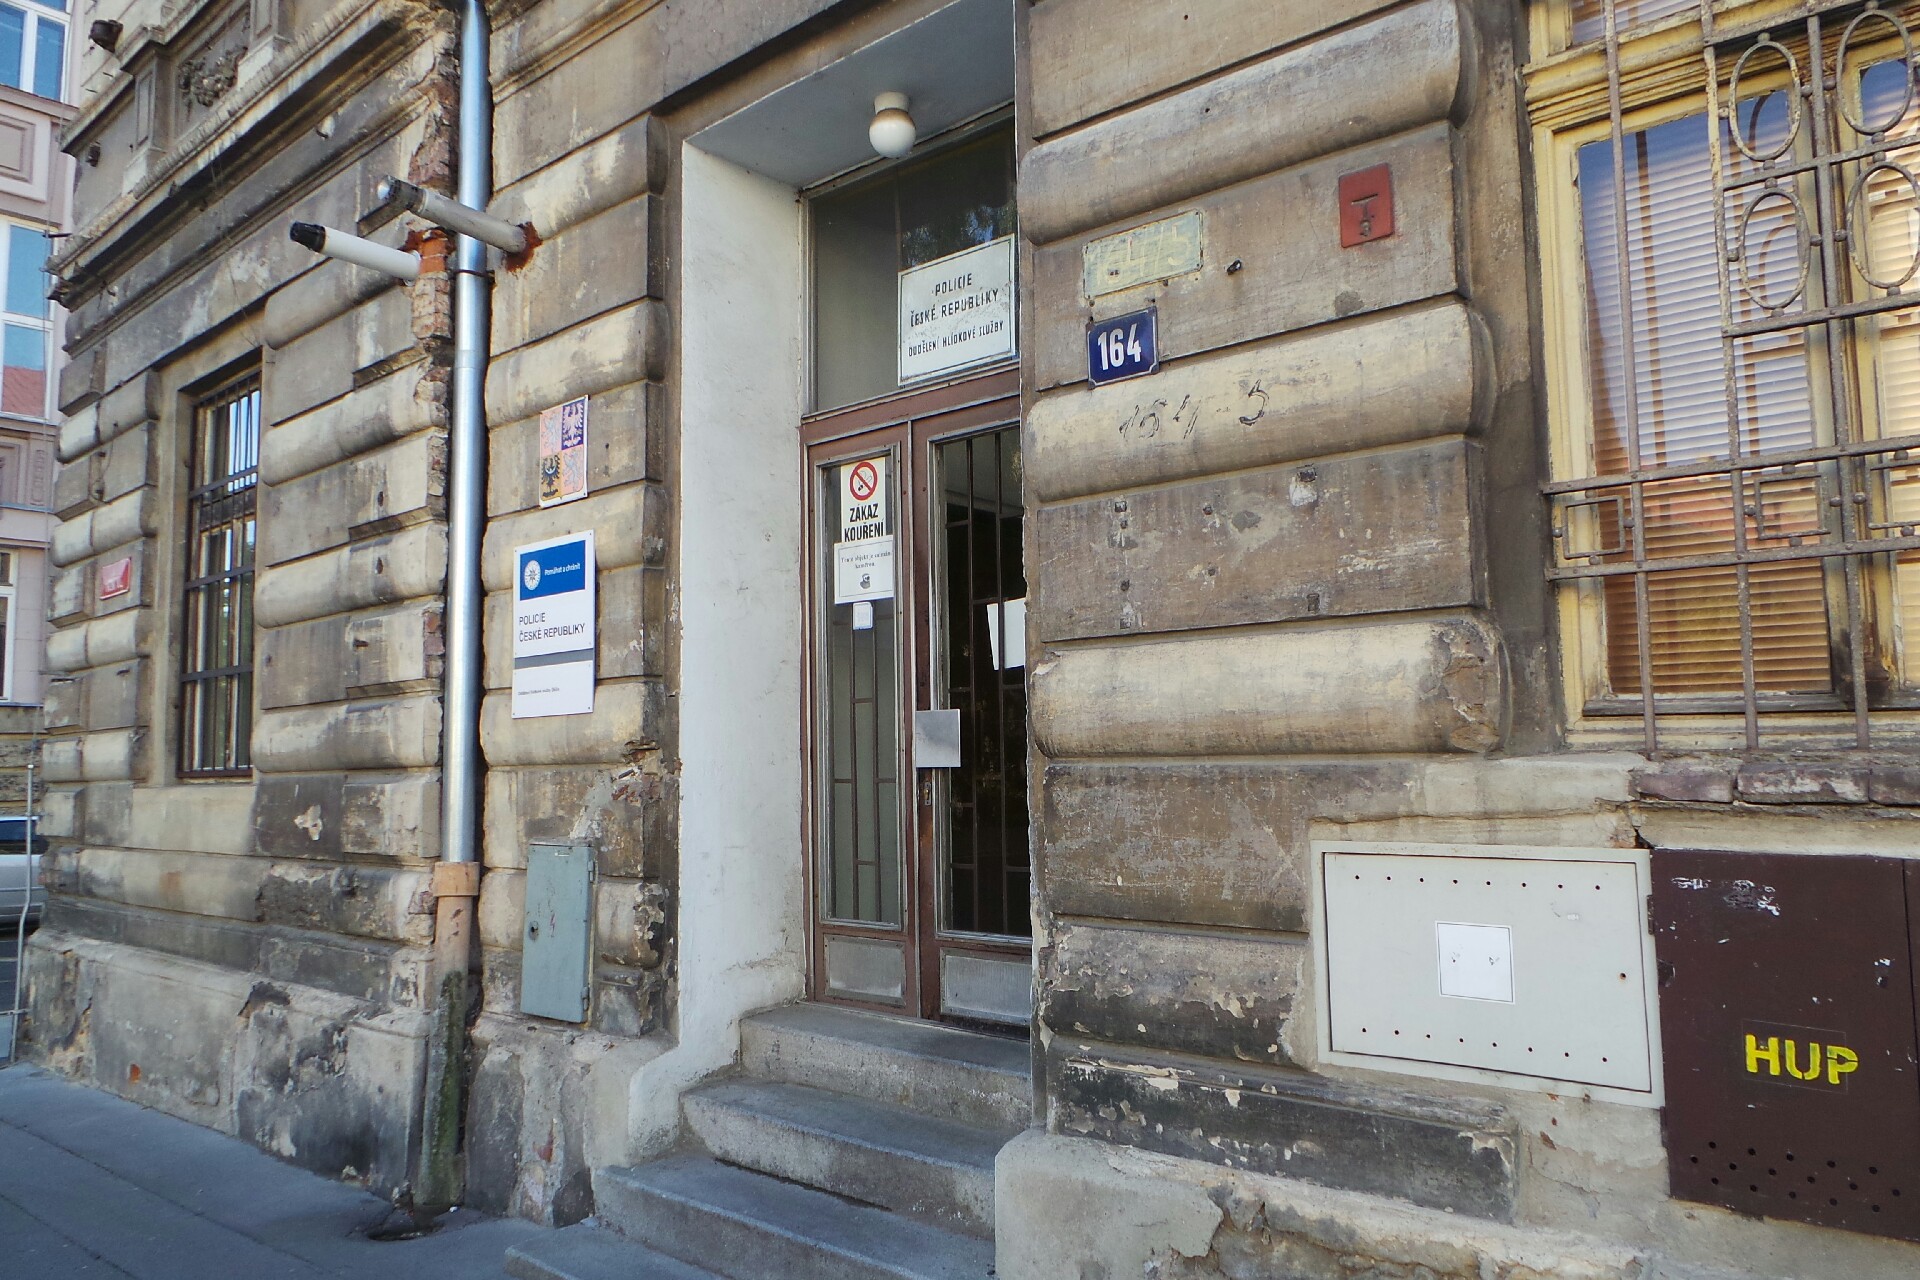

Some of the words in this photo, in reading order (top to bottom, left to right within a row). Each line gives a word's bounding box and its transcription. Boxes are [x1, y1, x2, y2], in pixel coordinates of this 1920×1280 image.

[935, 273, 972, 296] POLICIE
[910, 304, 937, 327] ČESKÉ
[941, 288, 999, 317] REPUBLIKY
[942, 326, 976, 347] HLÍDKOVÉ
[979, 320, 1004, 337] SLUŽBY
[1097, 323, 1142, 371] 164
[850, 503, 878, 522] ZÁKAZ
[844, 518, 884, 542] KOUŘENÍ
[519, 612, 546, 626] POLICIE
[518, 628, 542, 642] ČESKÉ
[543, 622, 586, 639] REPUBLIKY
[1745, 1034, 1858, 1084] HUP
